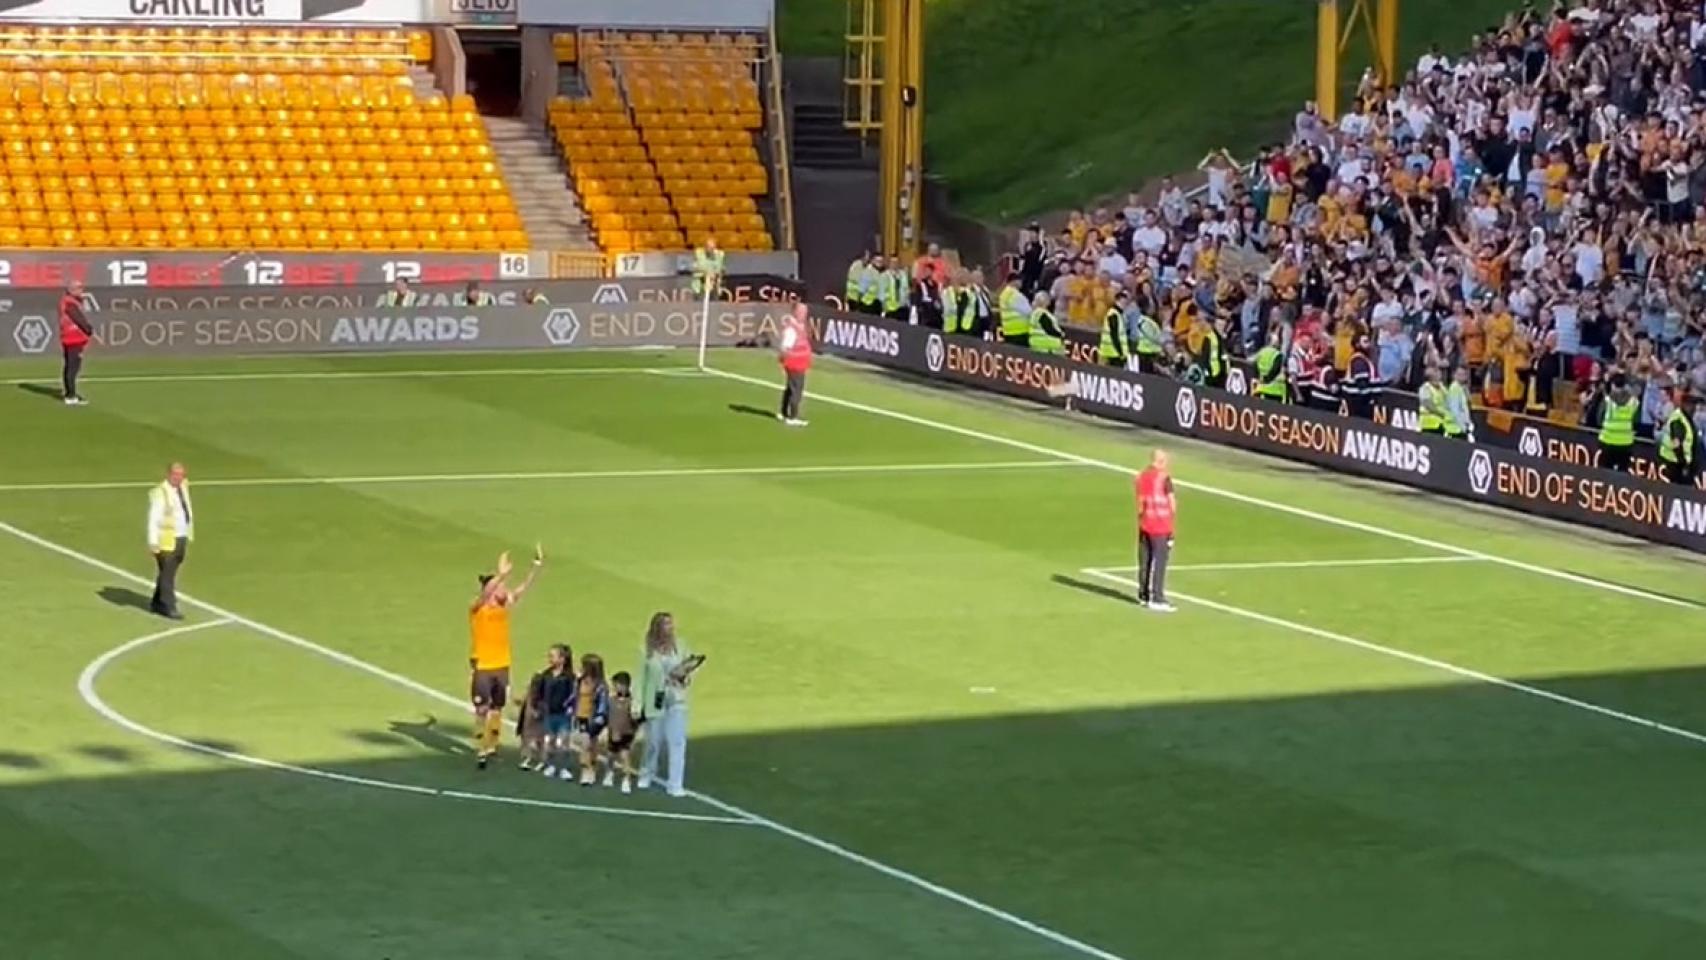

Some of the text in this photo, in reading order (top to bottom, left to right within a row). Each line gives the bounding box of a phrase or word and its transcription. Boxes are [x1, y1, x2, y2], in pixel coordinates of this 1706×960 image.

[244, 260, 361, 287] 12BET
[505, 256, 526, 273] 16
[622, 255, 640, 272] 17
[141, 320, 185, 346] OF
[195, 318, 321, 346] SEASON
[331, 316, 480, 344] AWARDS
[589, 311, 900, 357] END OF SEAN AWARDS
[947, 343, 1145, 413] END OF SEASON AWARDS
[1199, 398, 1432, 476] END OF SEASON AWARDS
[1496, 461, 1541, 499] END
[1544, 472, 1575, 504] OF
[1578, 478, 1664, 526] SEASON
